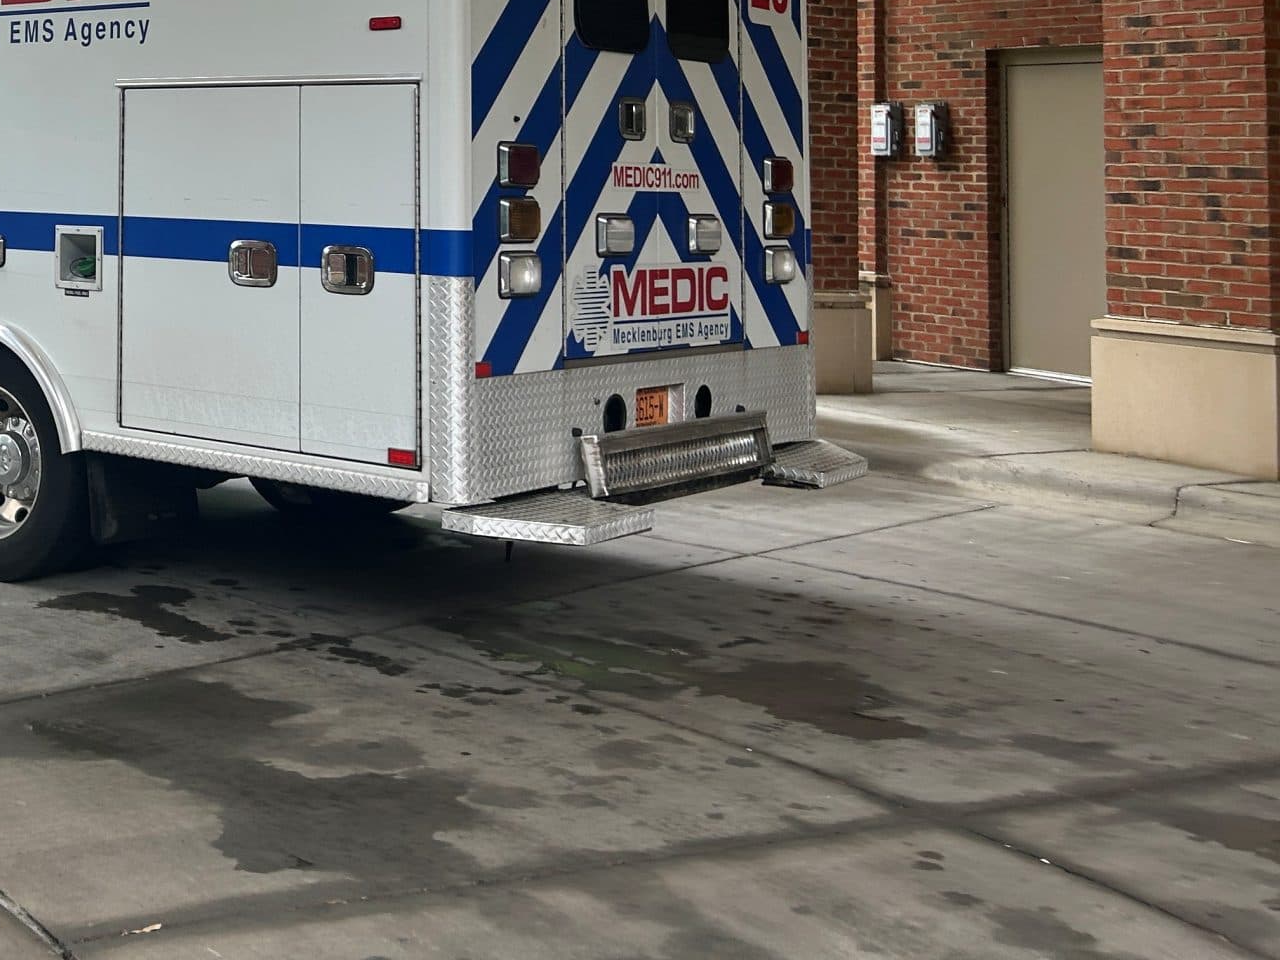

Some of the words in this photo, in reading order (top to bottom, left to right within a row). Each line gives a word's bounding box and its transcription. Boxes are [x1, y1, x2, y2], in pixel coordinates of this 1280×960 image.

[10, 19, 54, 44] EMS
[64, 17, 150, 47] Agency
[613, 165, 700, 189] MEDIC911.com
[613, 266, 729, 318] MEDIC
[613, 326, 672, 344] Mecklenburg
[676, 322, 695, 339] EMS
[698, 321, 729, 340] Agency
